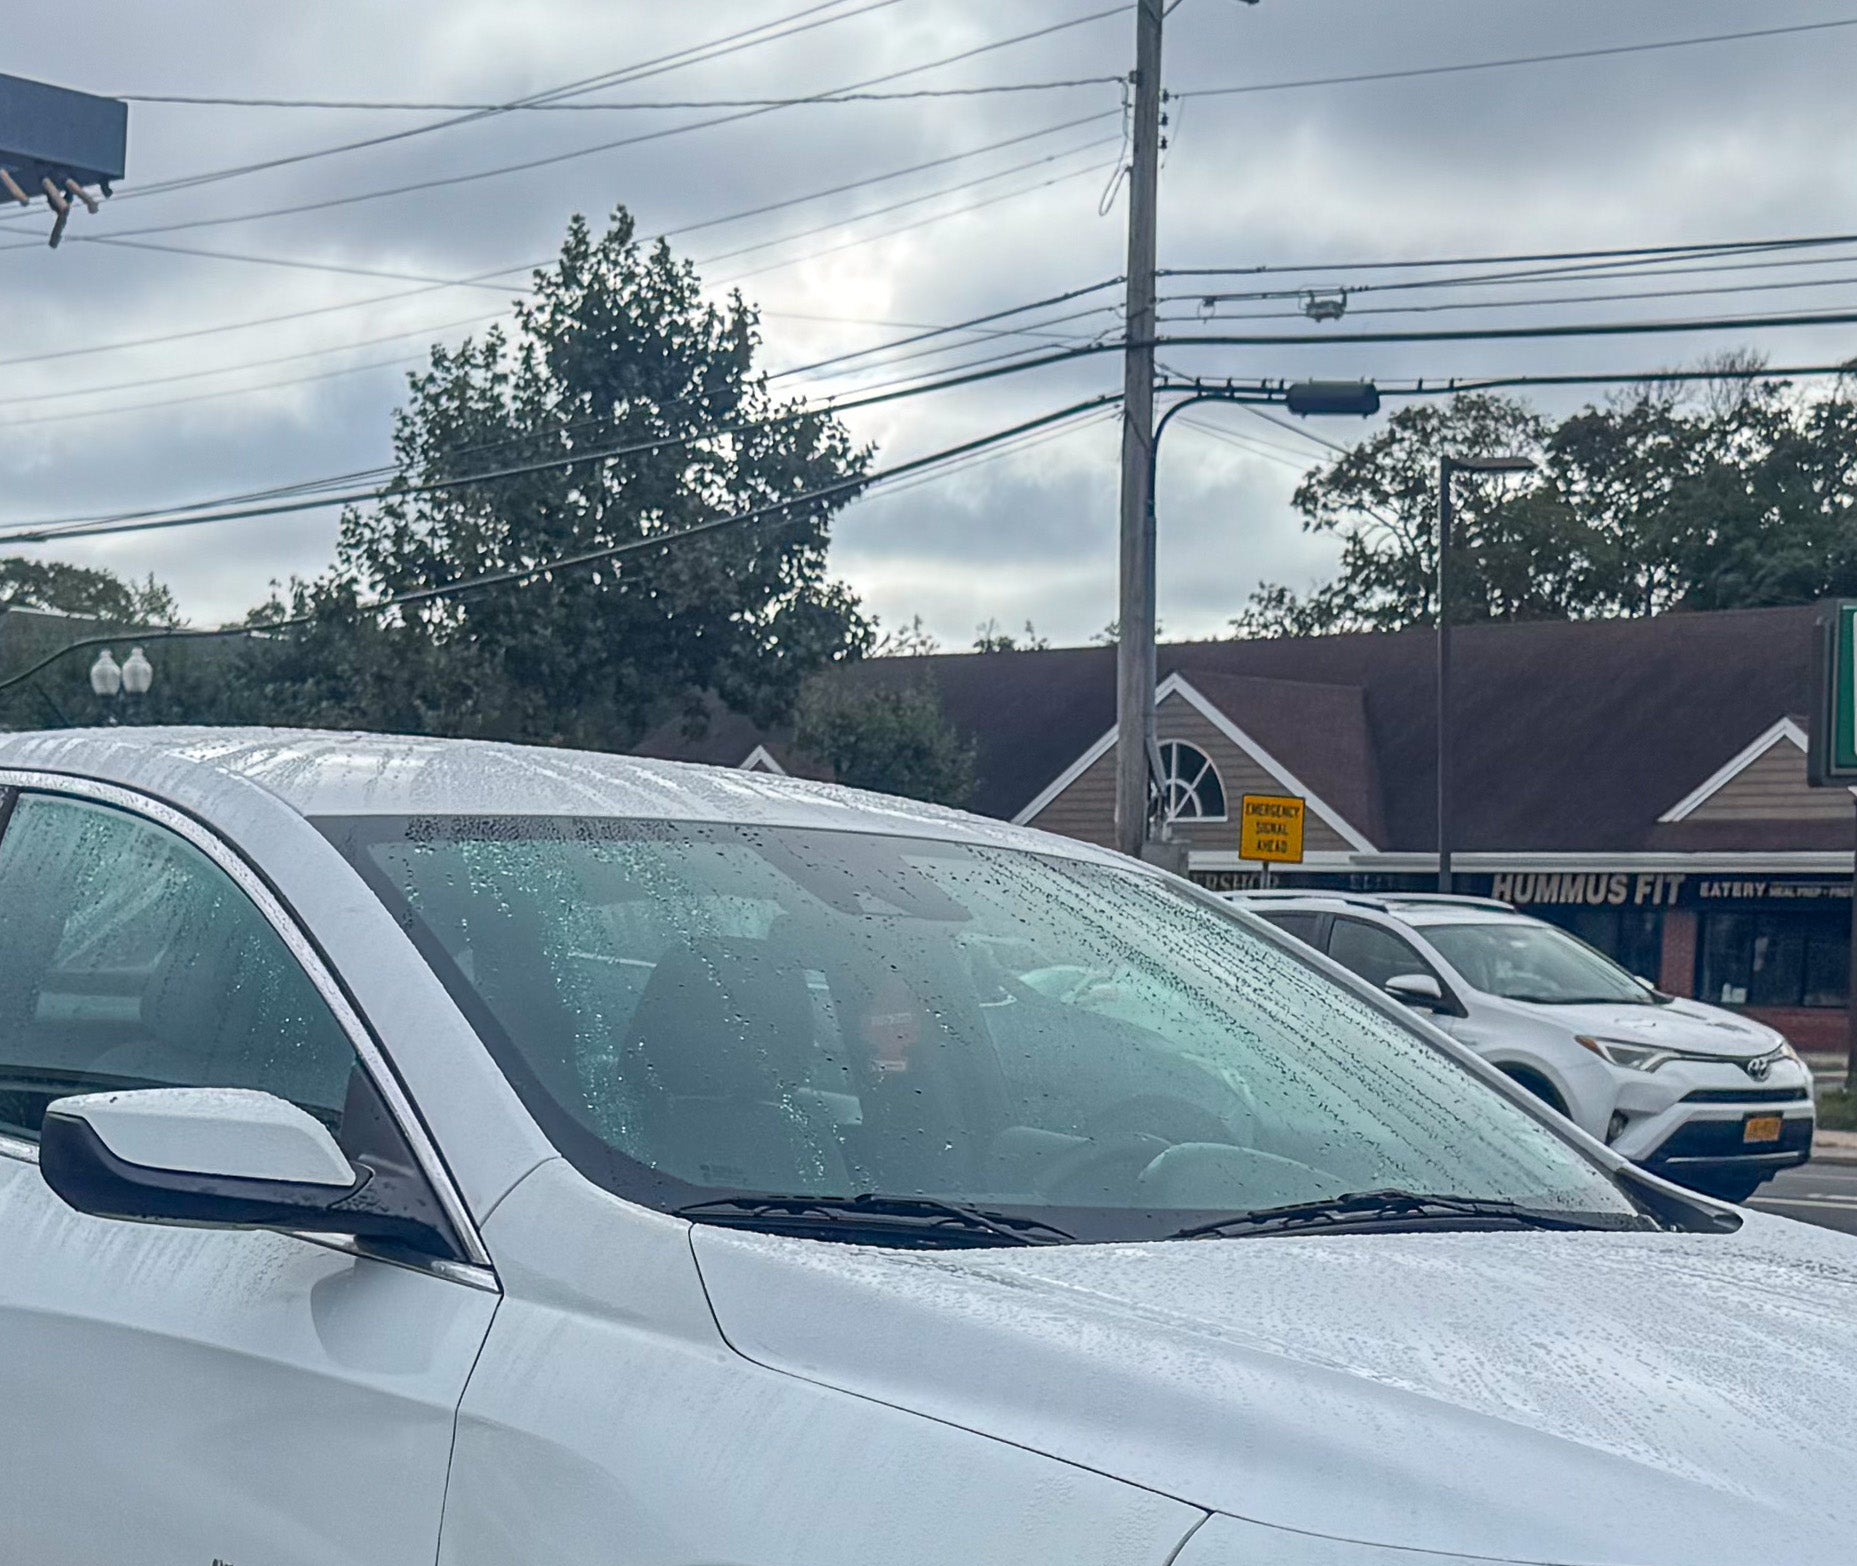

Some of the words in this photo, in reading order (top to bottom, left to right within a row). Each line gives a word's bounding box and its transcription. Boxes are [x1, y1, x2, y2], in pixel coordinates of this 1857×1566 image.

[1492, 873, 1627, 904] HUMMUS
[1634, 873, 1686, 905] FIT
[1700, 881, 1766, 898] EATERY
